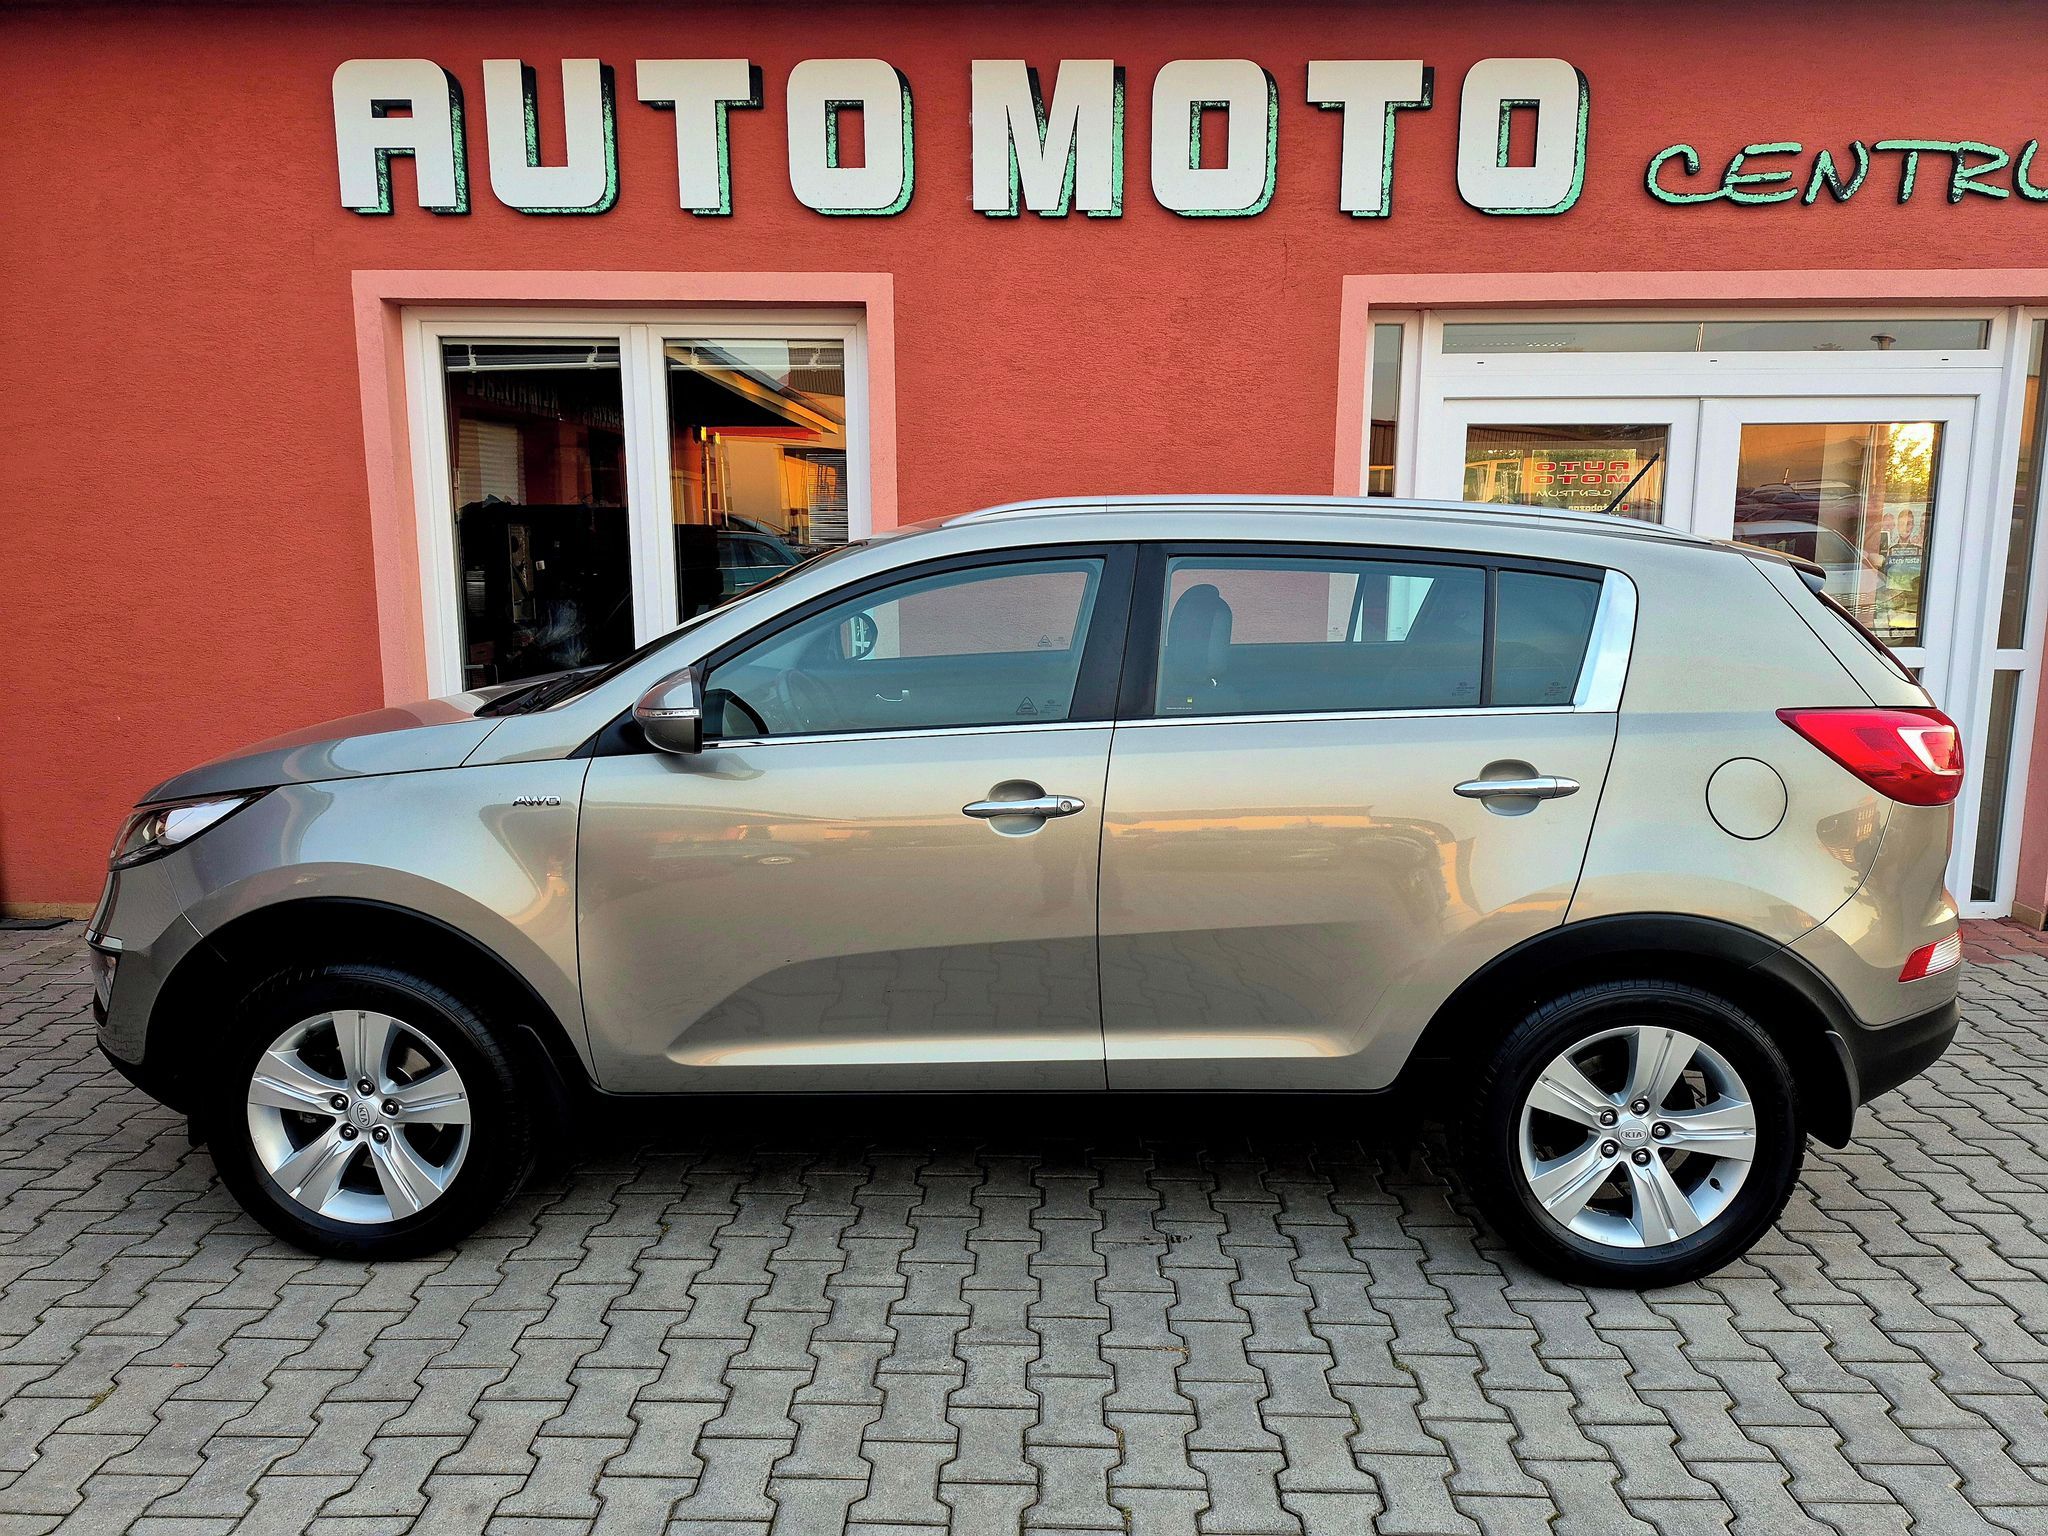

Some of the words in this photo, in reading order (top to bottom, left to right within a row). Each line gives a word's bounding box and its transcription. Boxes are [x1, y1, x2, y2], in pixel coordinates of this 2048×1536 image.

[332, 58, 914, 217] AUTO
[971, 57, 1590, 217] MOTO
[512, 795, 561, 806] AWD
